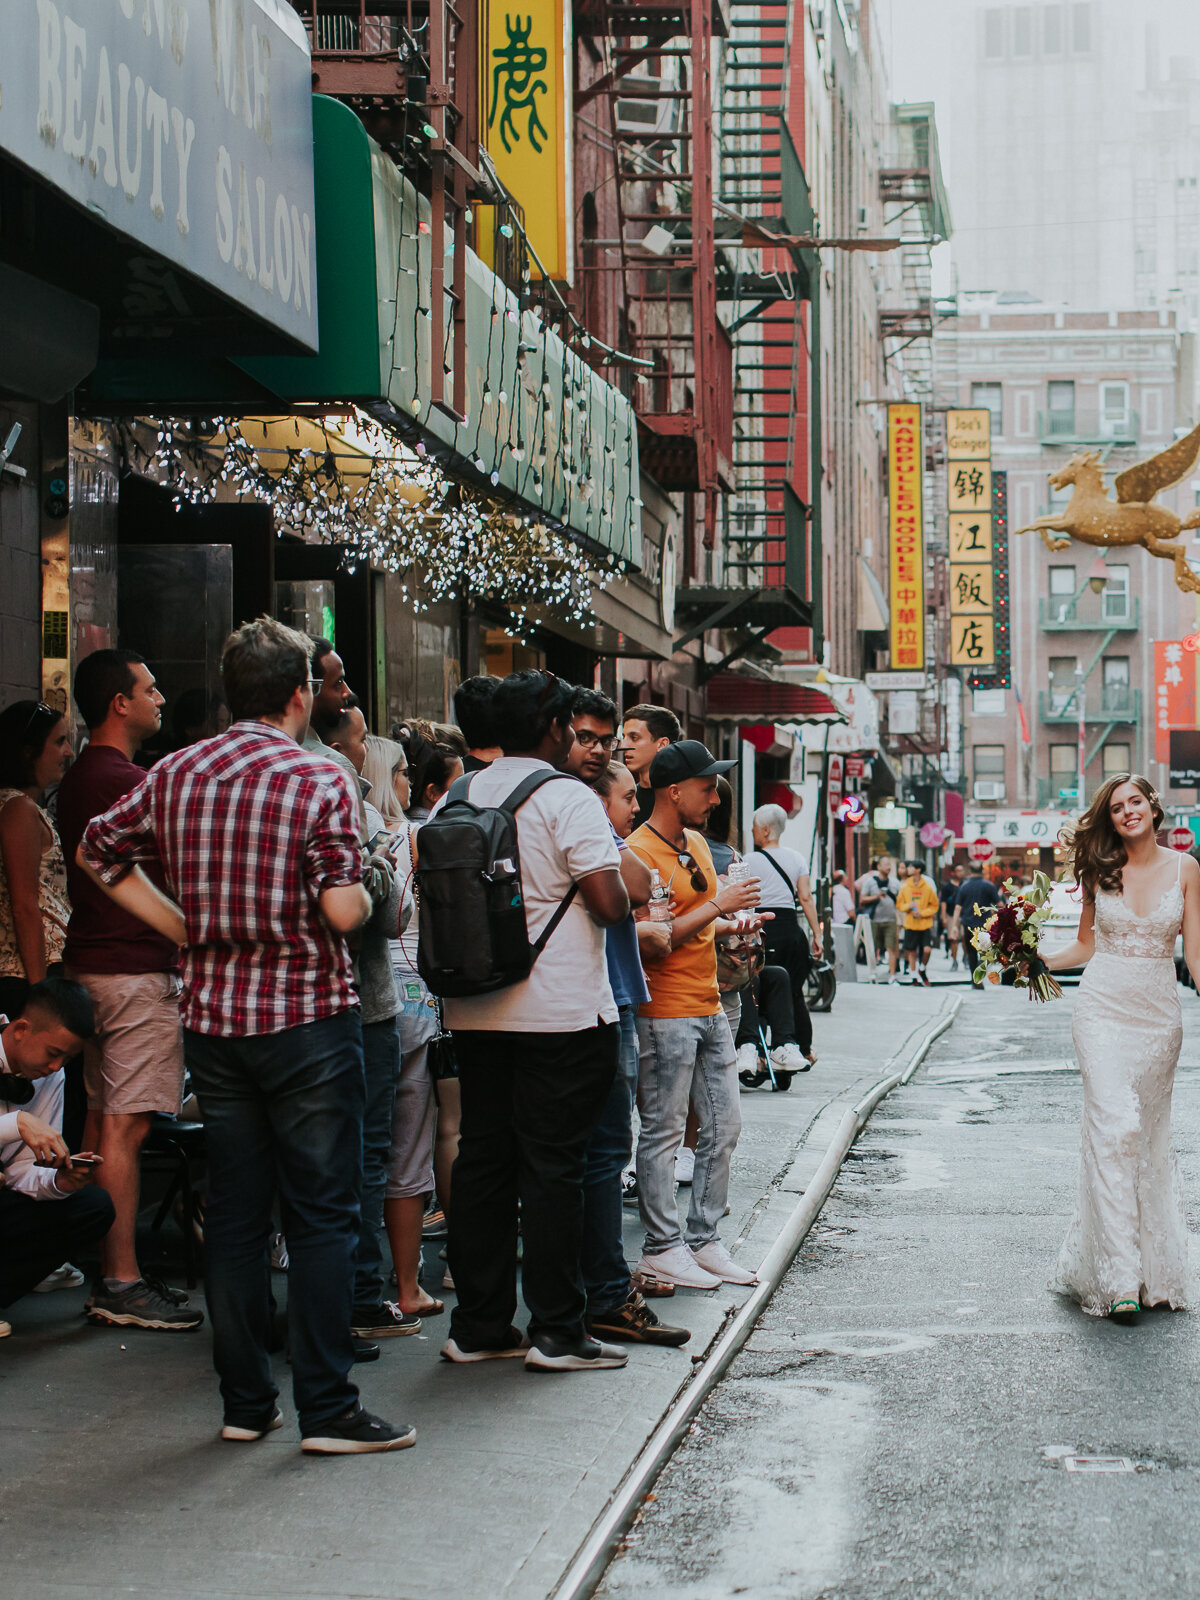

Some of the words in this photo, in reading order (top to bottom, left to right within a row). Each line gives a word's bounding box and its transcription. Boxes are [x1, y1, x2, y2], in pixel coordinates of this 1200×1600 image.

[37, 0, 196, 236] BEAUTY
[216, 145, 311, 318] SALON
[954, 415, 982, 431] Joe's
[950, 436, 988, 452] Ginger
[954, 466, 991, 660] 錦江飯店
[1169, 834, 1193, 844] STOP
